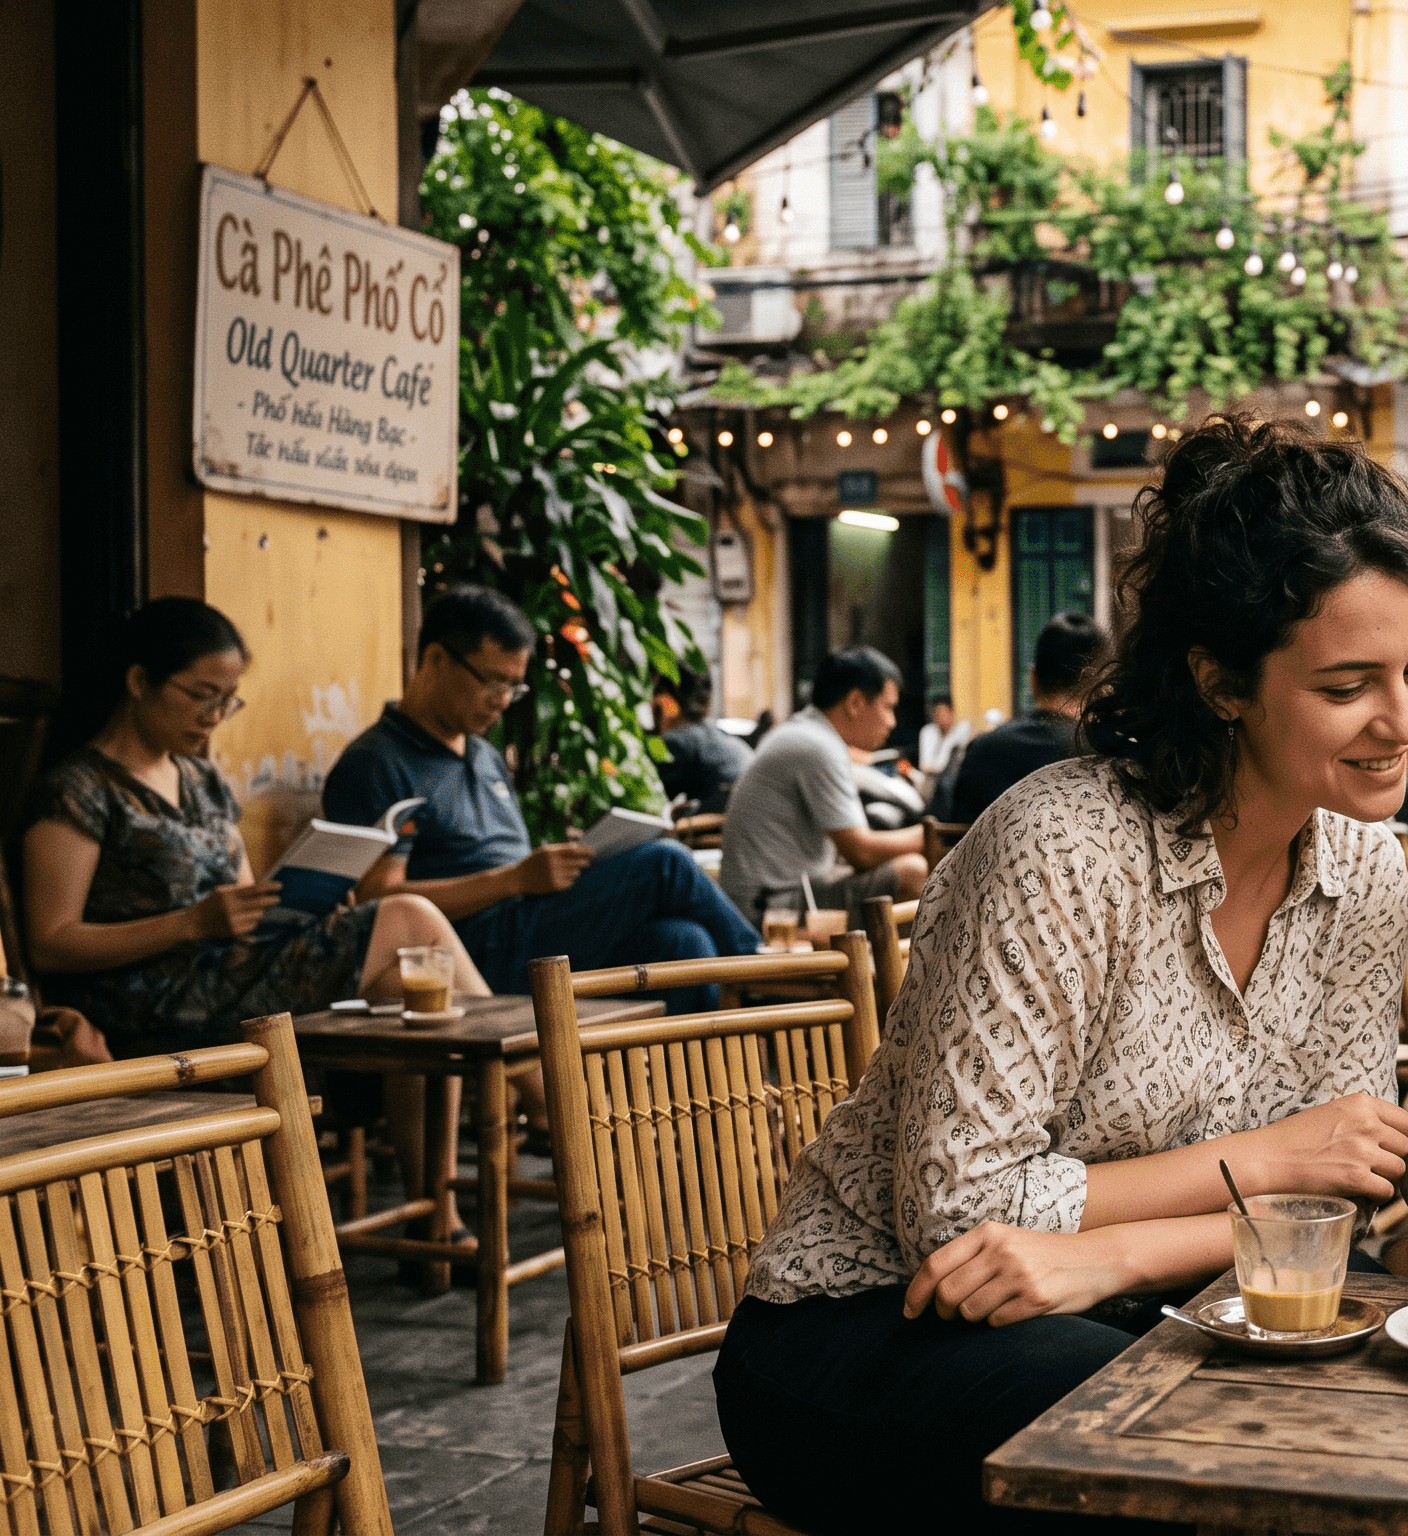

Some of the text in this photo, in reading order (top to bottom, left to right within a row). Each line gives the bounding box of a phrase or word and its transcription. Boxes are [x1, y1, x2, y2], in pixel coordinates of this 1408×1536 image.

[216, 213, 447, 344] Cà Phê Phố Cổ
[226, 316, 435, 410] Old Quarter Café
